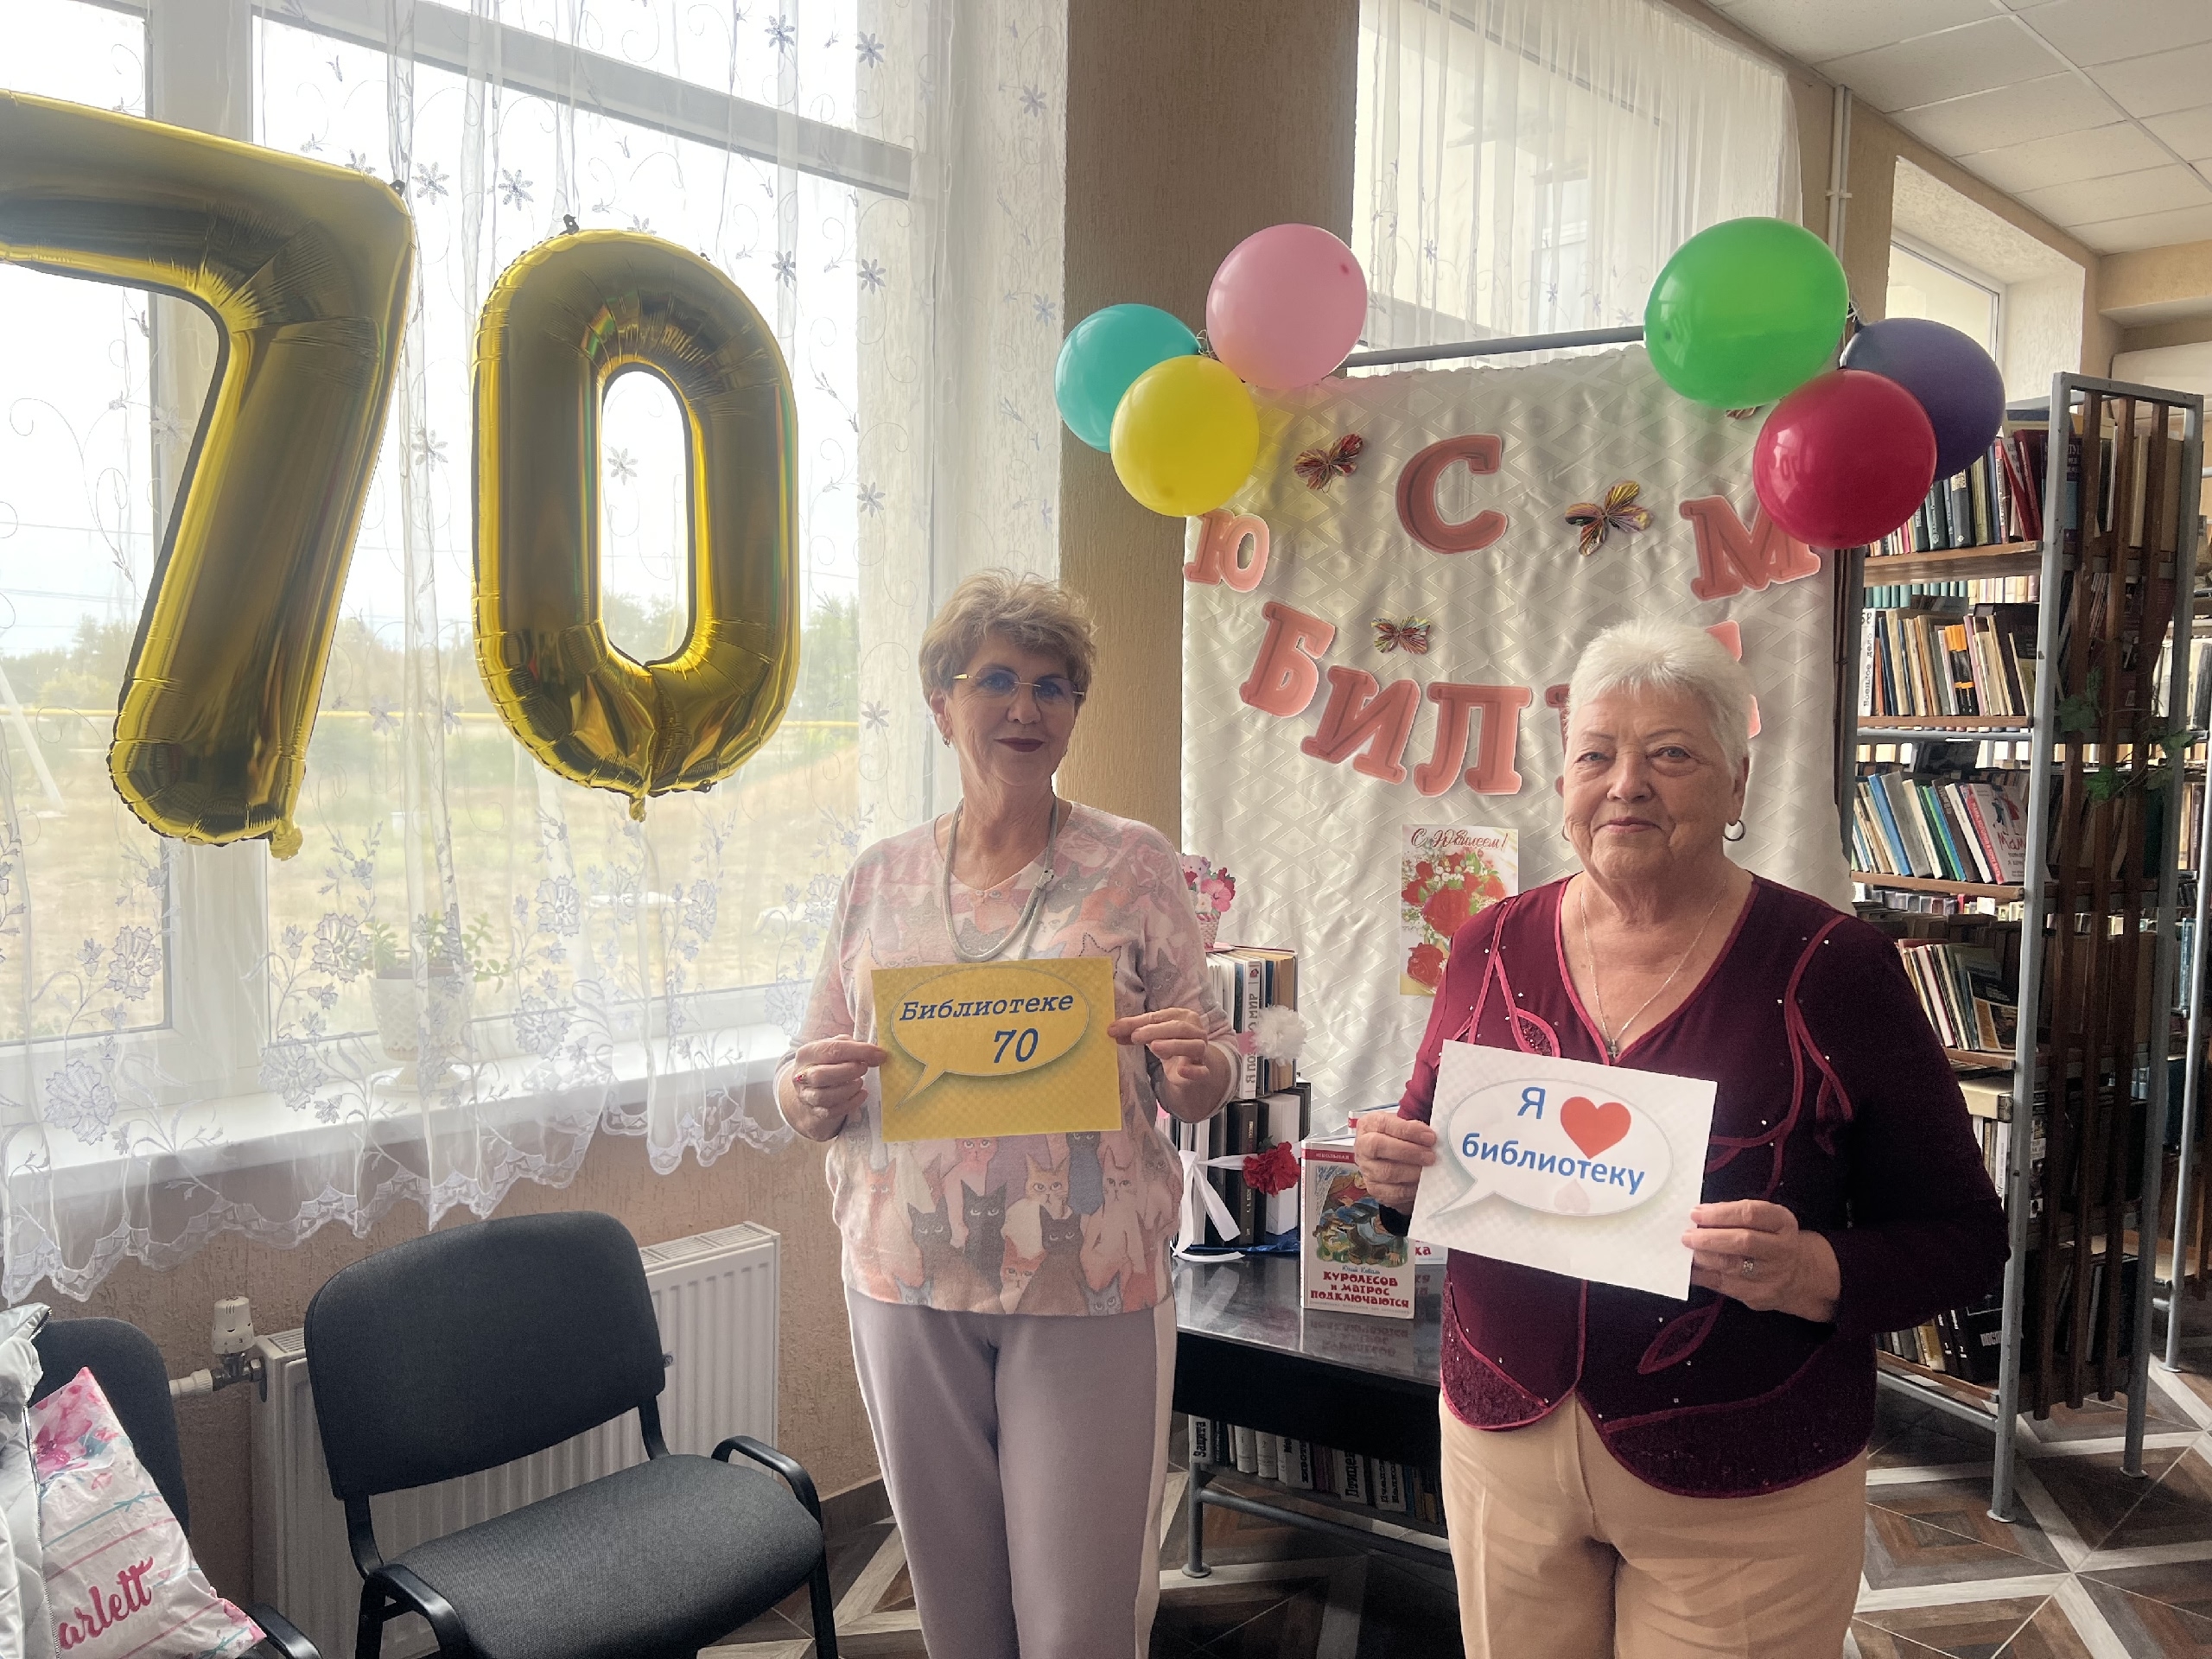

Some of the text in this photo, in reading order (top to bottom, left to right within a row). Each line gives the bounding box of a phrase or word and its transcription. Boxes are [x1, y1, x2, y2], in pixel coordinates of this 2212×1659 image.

[0, 90, 800, 861] 70
[1395, 433, 1508, 555] С
[1411, 828, 1427, 847] С
[899, 994, 1074, 1021] Библиотеке
[993, 1027, 1039, 1064] 70
[1517, 1086, 1547, 1120] Я
[1462, 1132, 1645, 1195] библиотеку
[59, 1556, 154, 1649] arlett
